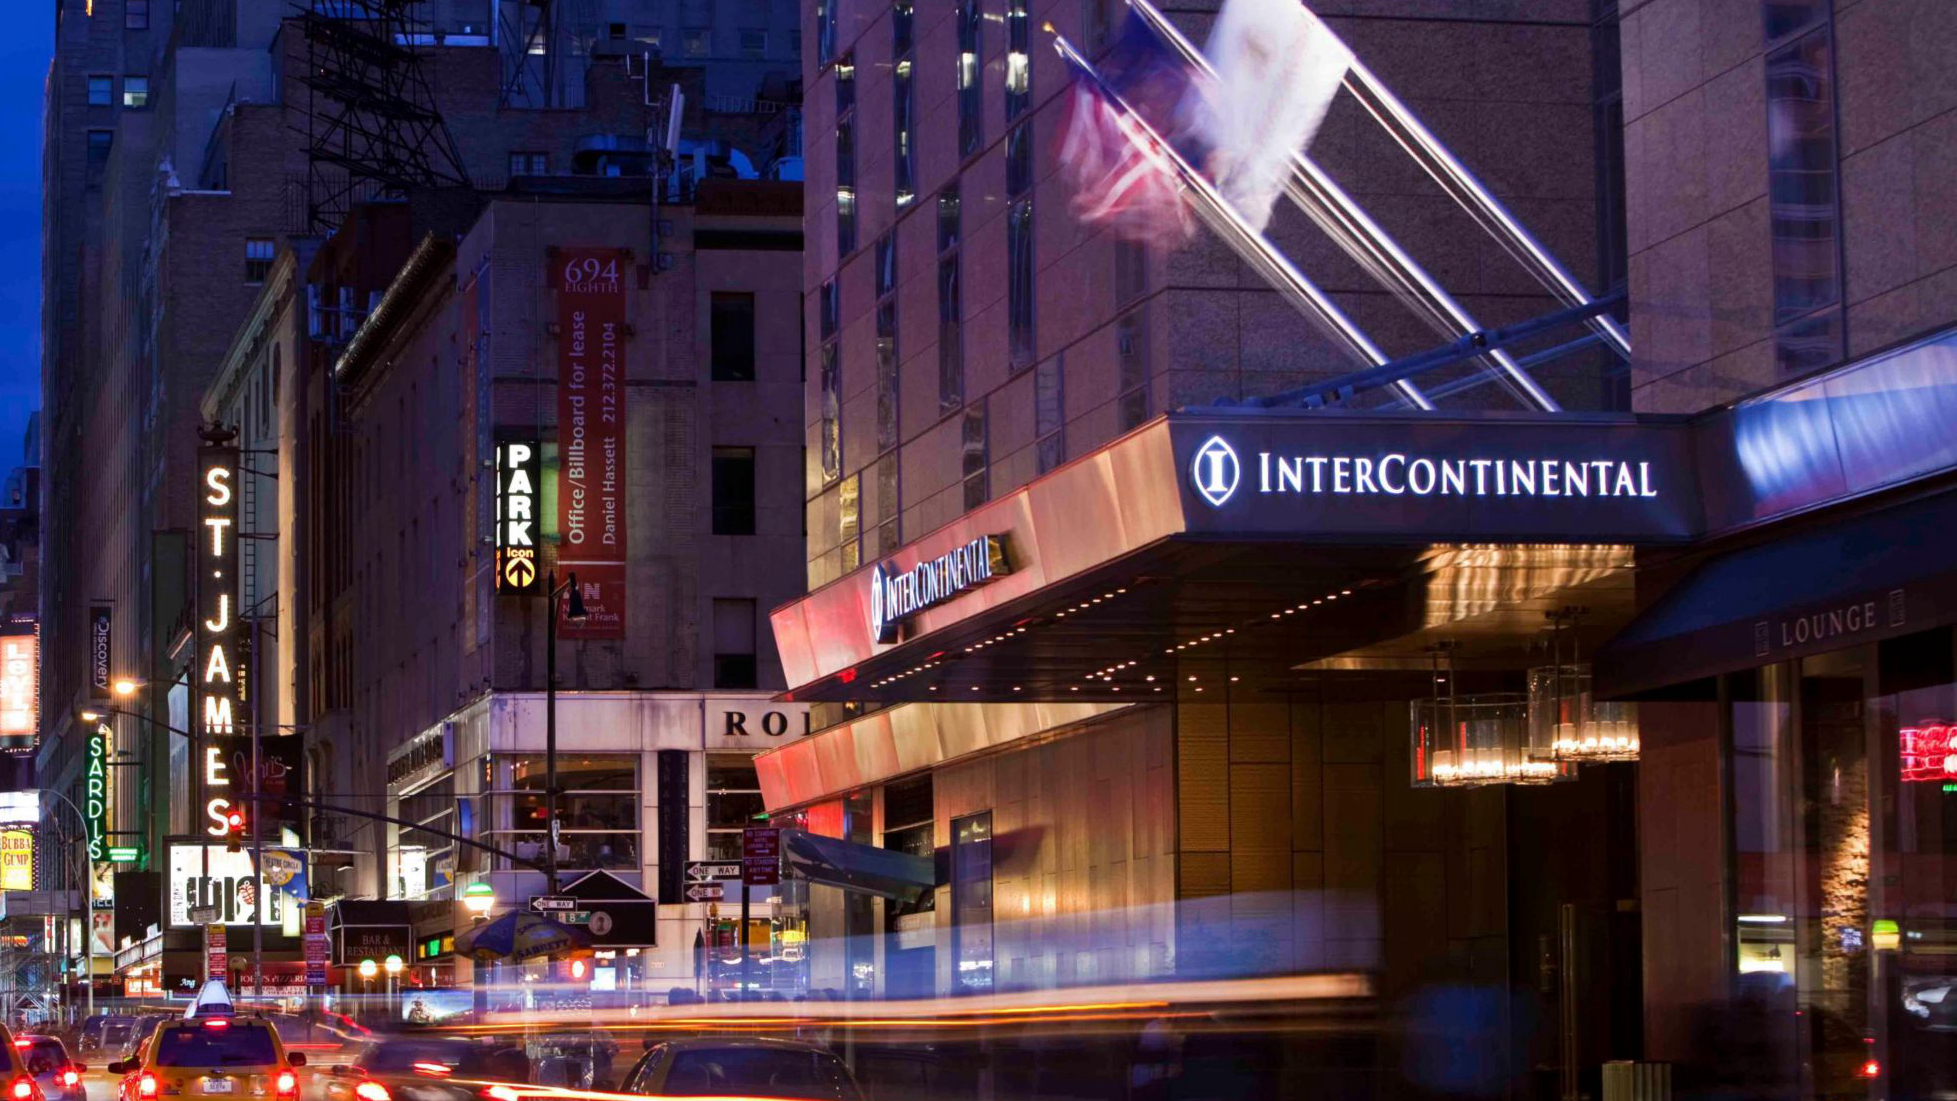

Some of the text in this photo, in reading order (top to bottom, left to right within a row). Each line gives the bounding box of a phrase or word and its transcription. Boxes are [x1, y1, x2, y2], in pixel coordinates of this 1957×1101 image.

[565, 258, 619, 283] 694
[565, 282, 618, 293] EIGHTH
[568, 311, 586, 544] Office/Billboard for lease
[602, 322, 616, 545] Daniel Hassett 212.372.2104
[1258, 452, 1658, 497] INTERCONTINENTAL
[508, 444, 533, 545] PARK
[507, 547, 534, 558] icon
[886, 535, 992, 622] INTERCONTINENTAL
[562, 604, 606, 612] Nmark
[1781, 602, 1876, 646] LOUNGE
[95, 622, 109, 690] Discovery
[205, 594, 233, 838] JAMES
[1, 836, 31, 850] BUBBA
[4, 853, 29, 866] GUMP
[693, 866, 736, 875] ONE WAY
[691, 888, 708, 897] ONE
[536, 900, 571, 908] ONE WAY
[362, 935, 380, 945] BAR
[347, 946, 405, 957] RESTAURANT
